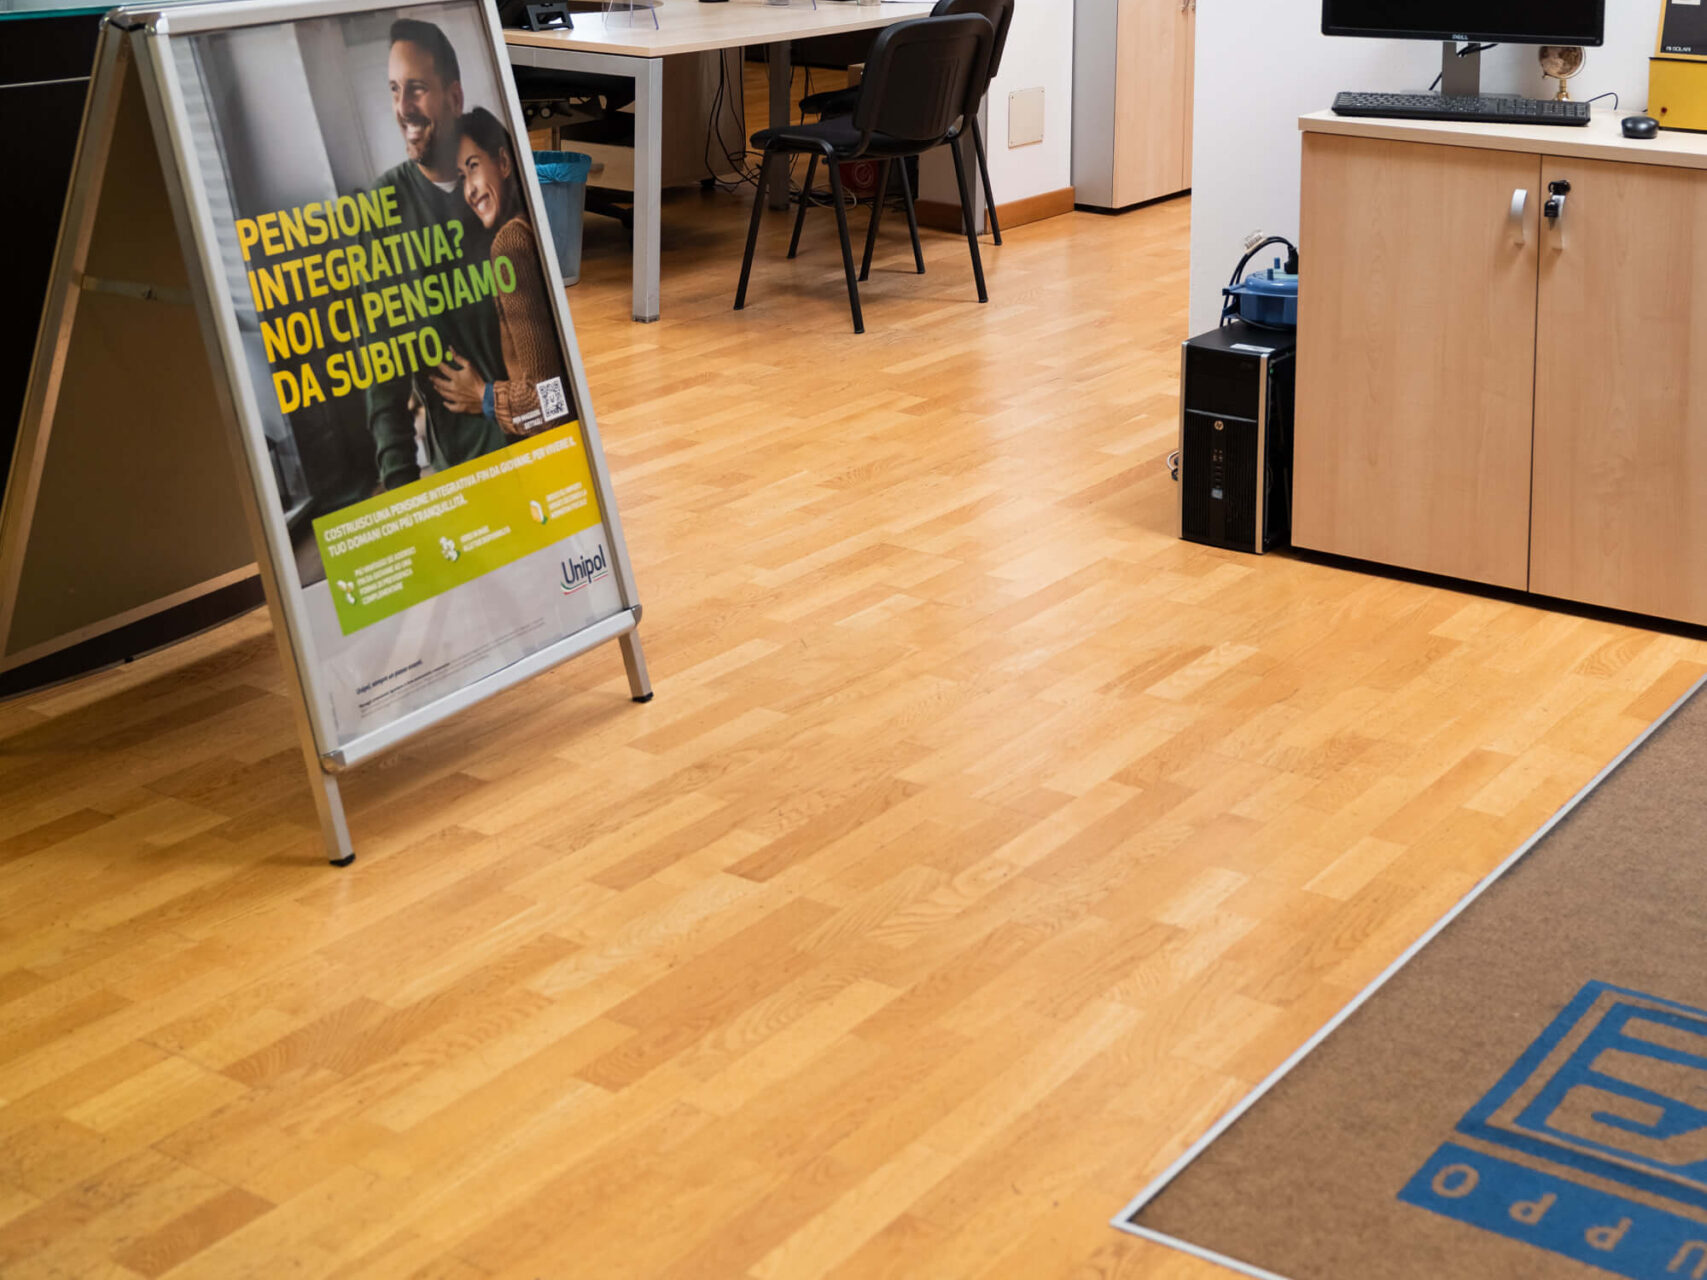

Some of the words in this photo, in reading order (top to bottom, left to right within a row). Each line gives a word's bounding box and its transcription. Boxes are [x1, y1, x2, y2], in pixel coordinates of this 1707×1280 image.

[235, 185, 402, 261] PENSIONE
[248, 220, 464, 312] INTEGRATIVA?
[260, 308, 324, 363] NOI
[327, 298, 360, 342] CI
[362, 255, 517, 333] PENSIAMO
[272, 363, 326, 414] DA
[325, 326, 453, 397] SUBITO.
[389, 492, 430, 517] PENSIONE
[562, 544, 606, 584] Unipol
